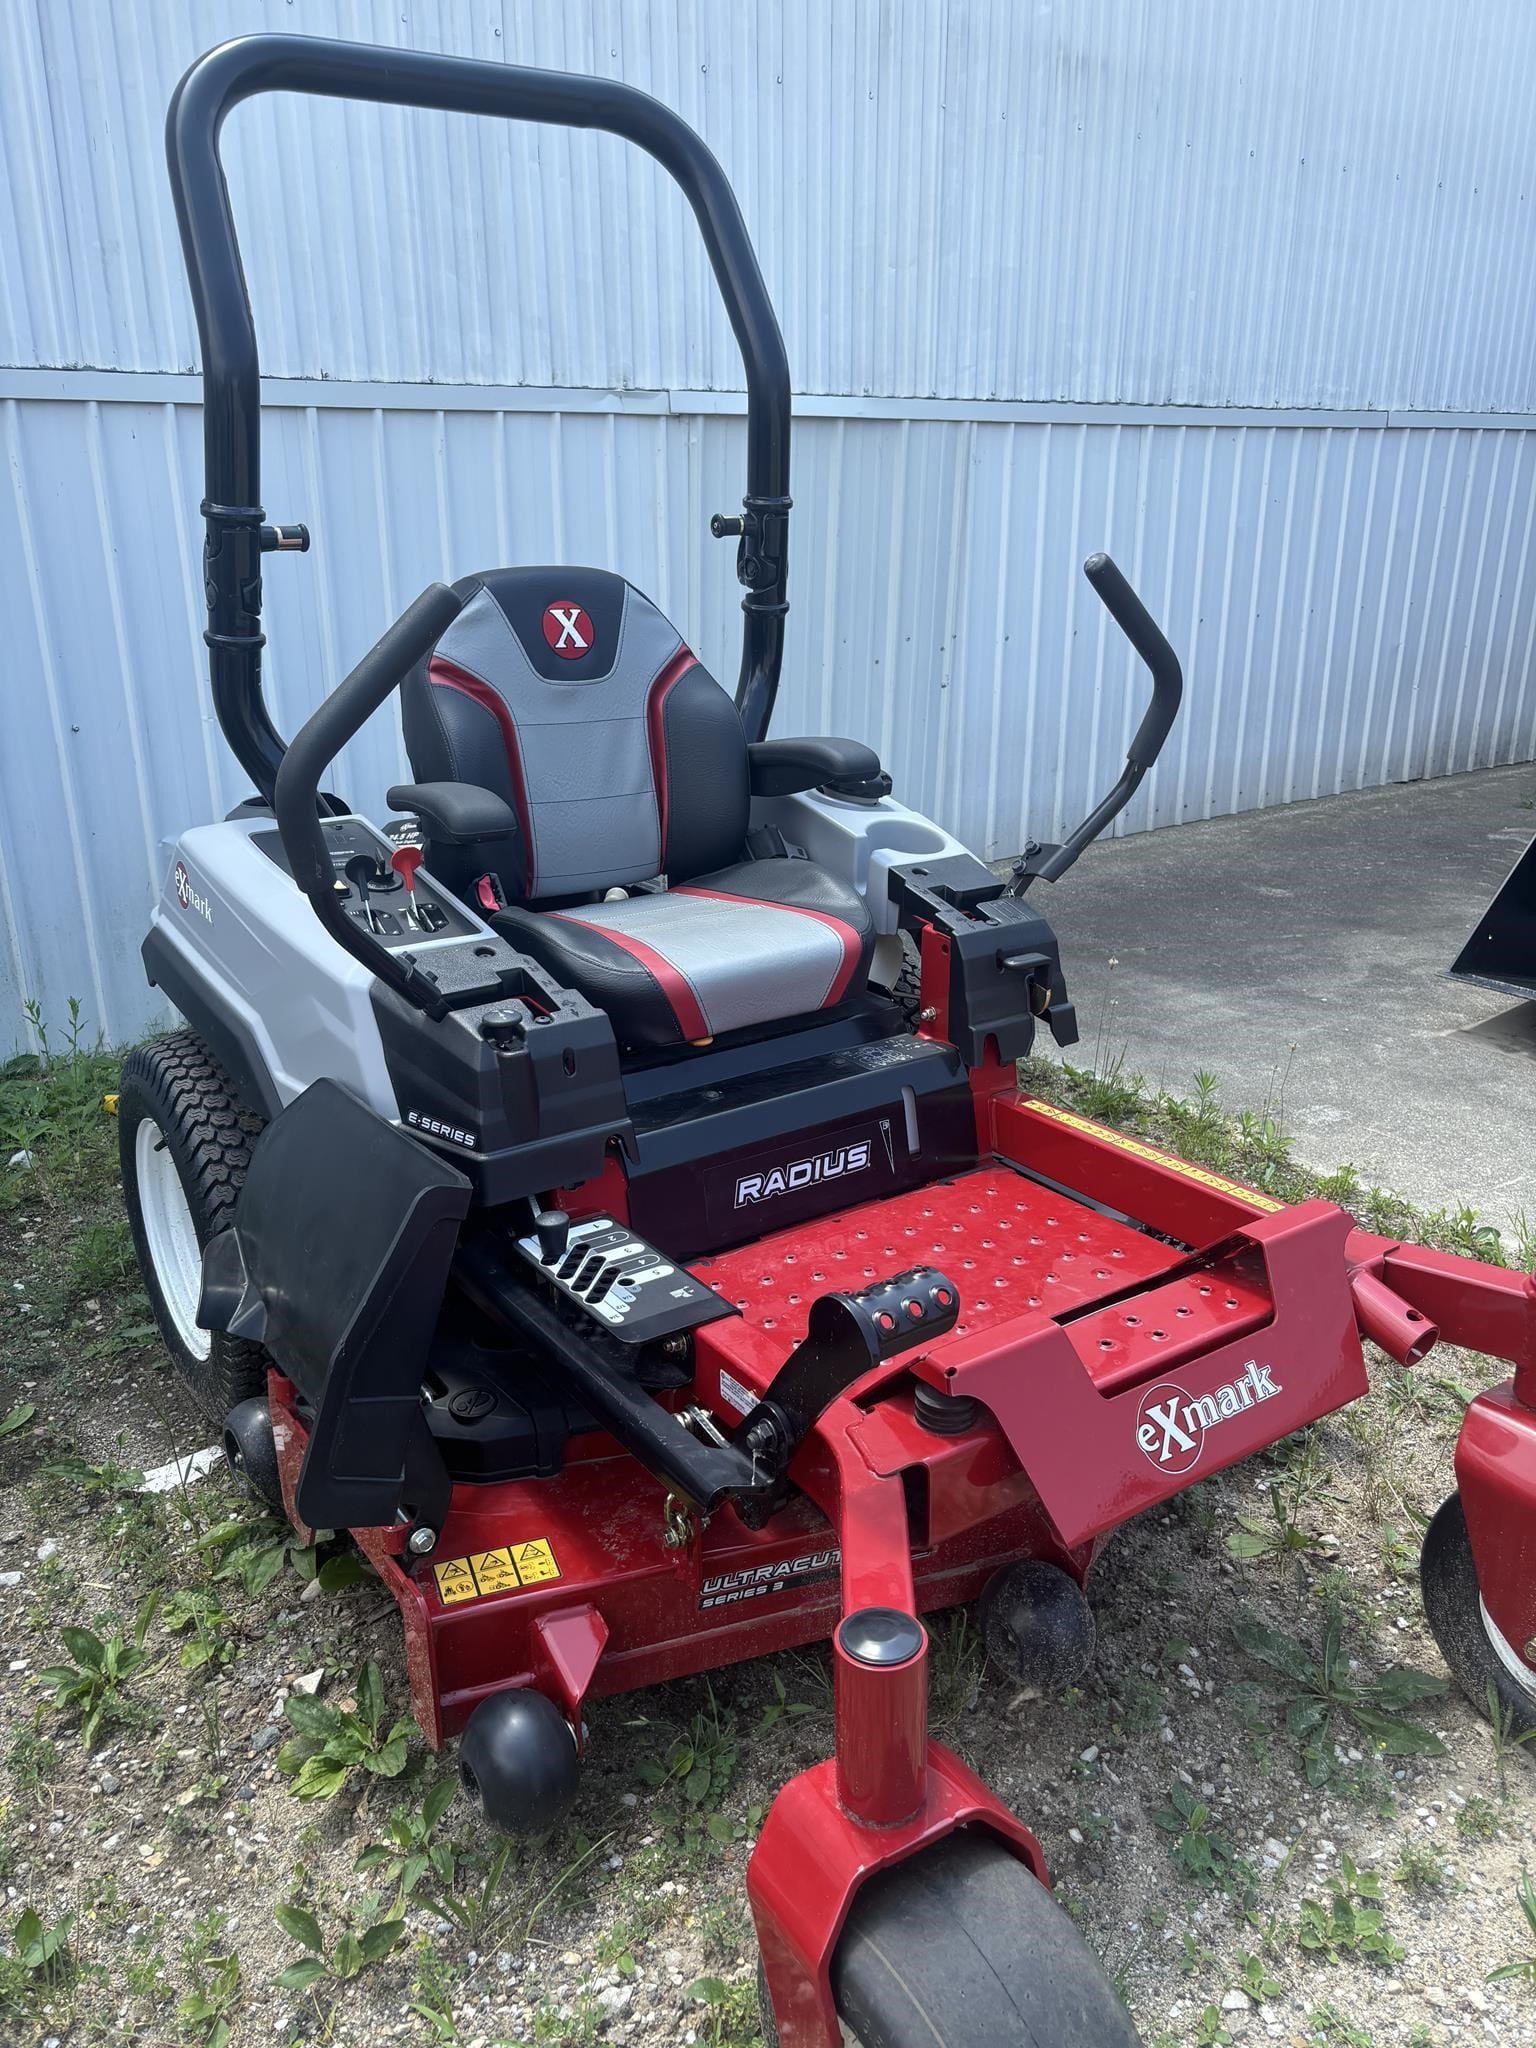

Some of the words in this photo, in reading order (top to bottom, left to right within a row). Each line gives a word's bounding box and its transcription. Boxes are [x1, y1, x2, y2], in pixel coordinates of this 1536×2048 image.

[548, 608, 589, 648] X
[174, 866, 213, 924] eXmark
[407, 1111, 476, 1147] E-SERIES
[736, 1142, 870, 1207] RADIUS
[1137, 1361, 1280, 1463] eXmark
[701, 1550, 842, 1594] ULTRACUT
[702, 1586, 767, 1609] SERIES
[772, 1580, 785, 1592] 3
